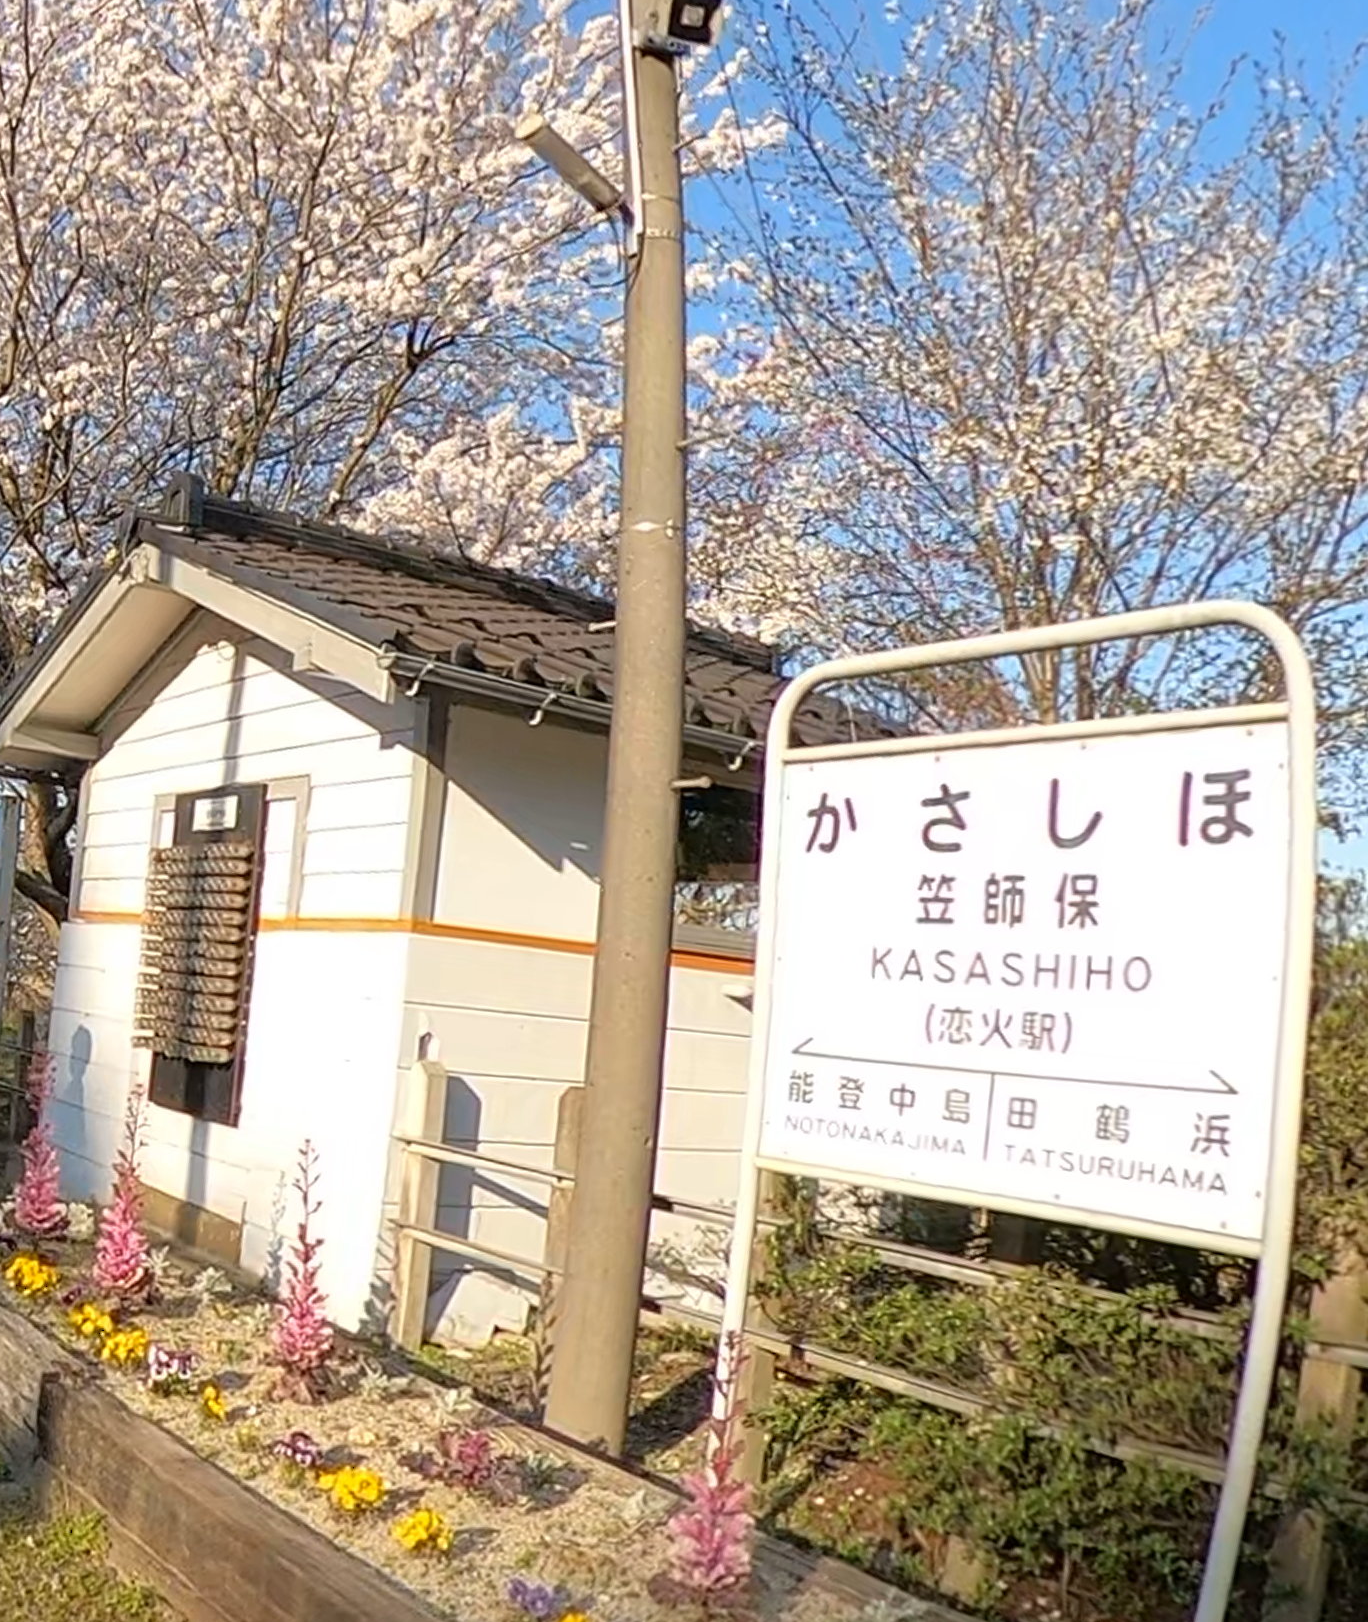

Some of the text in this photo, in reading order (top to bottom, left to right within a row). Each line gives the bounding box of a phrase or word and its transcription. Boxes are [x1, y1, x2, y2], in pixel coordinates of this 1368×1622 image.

[806, 768, 1254, 854] かさしほ
[916, 872, 1099, 928] 笠師保
[871, 946, 1152, 992] KASASHIHO
[925, 1003, 1073, 1054] (恋火駅)
[788, 1070, 971, 1124] 能登中島
[784, 1114, 967, 1155] NOTONAKAJIMA
[1007, 1097, 1231, 1157] 田鶴浜
[1004, 1144, 1228, 1195] TATSURUHAMA
